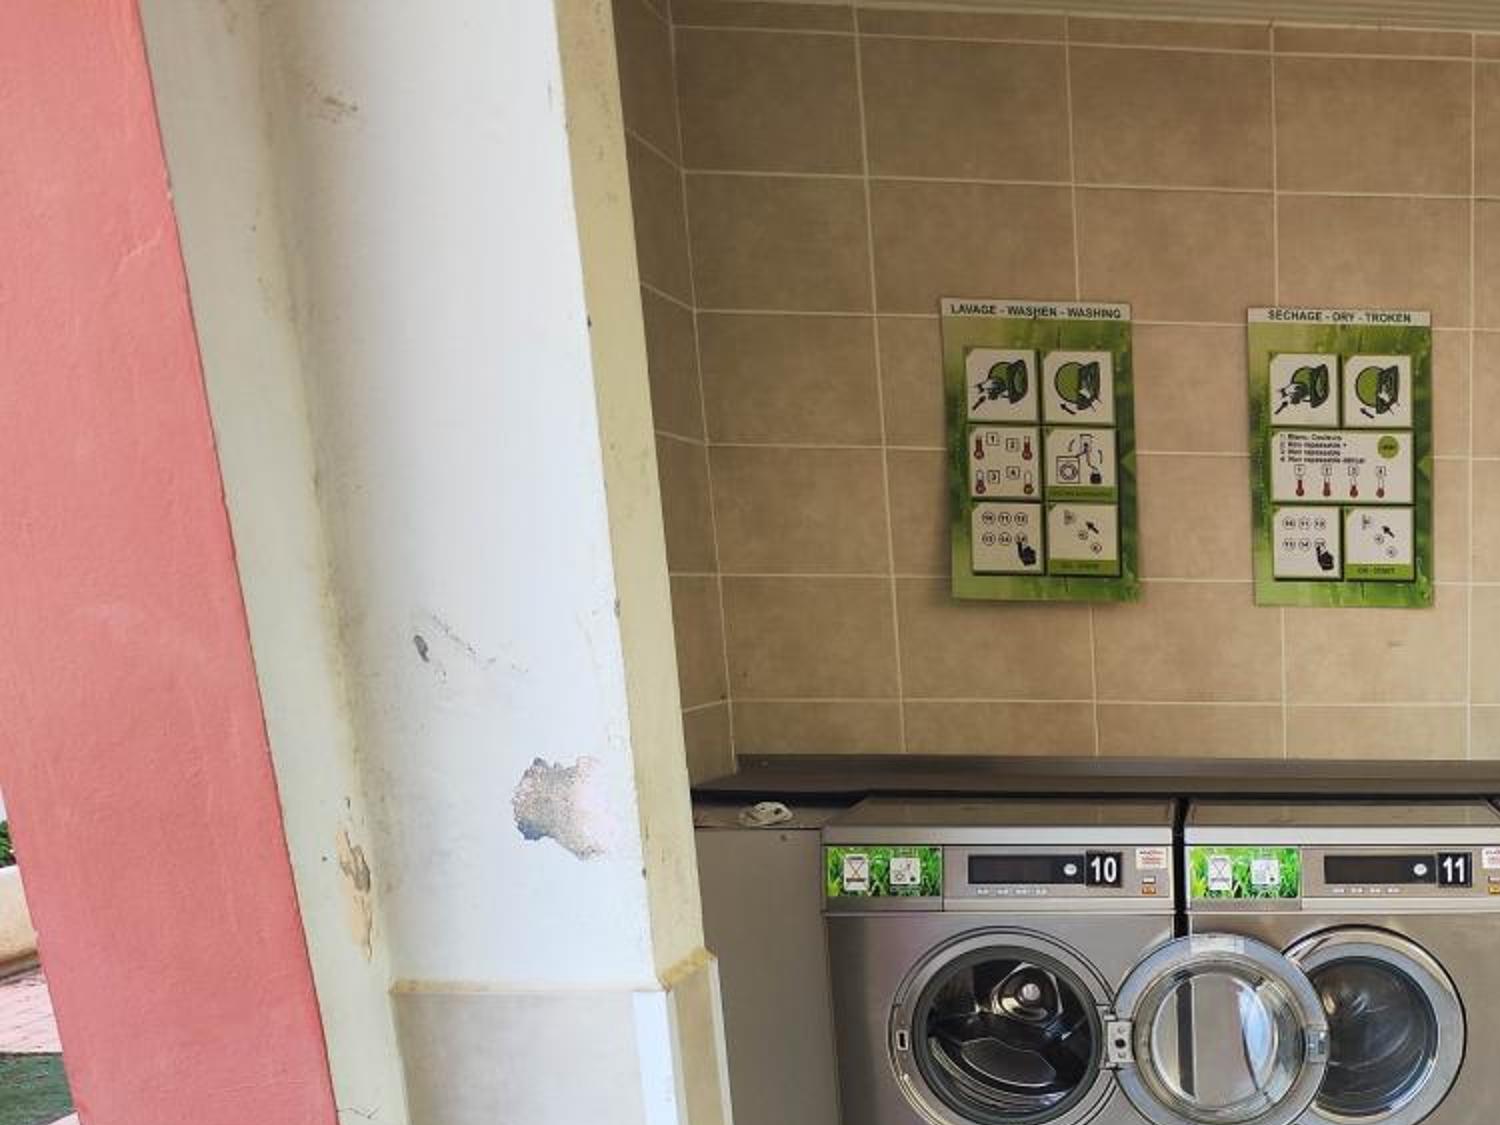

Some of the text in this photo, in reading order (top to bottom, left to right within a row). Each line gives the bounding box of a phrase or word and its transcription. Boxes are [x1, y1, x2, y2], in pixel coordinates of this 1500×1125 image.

[951, 304, 995, 315] LAVAGE
[1068, 307, 1121, 318] WASHING
[1268, 310, 1322, 321] SECHAGE
[1332, 311, 1355, 322] DRY
[1365, 312, 1411, 323] TROKEN
[1091, 856, 1117, 883] 10
[1443, 856, 1464, 883] 11
